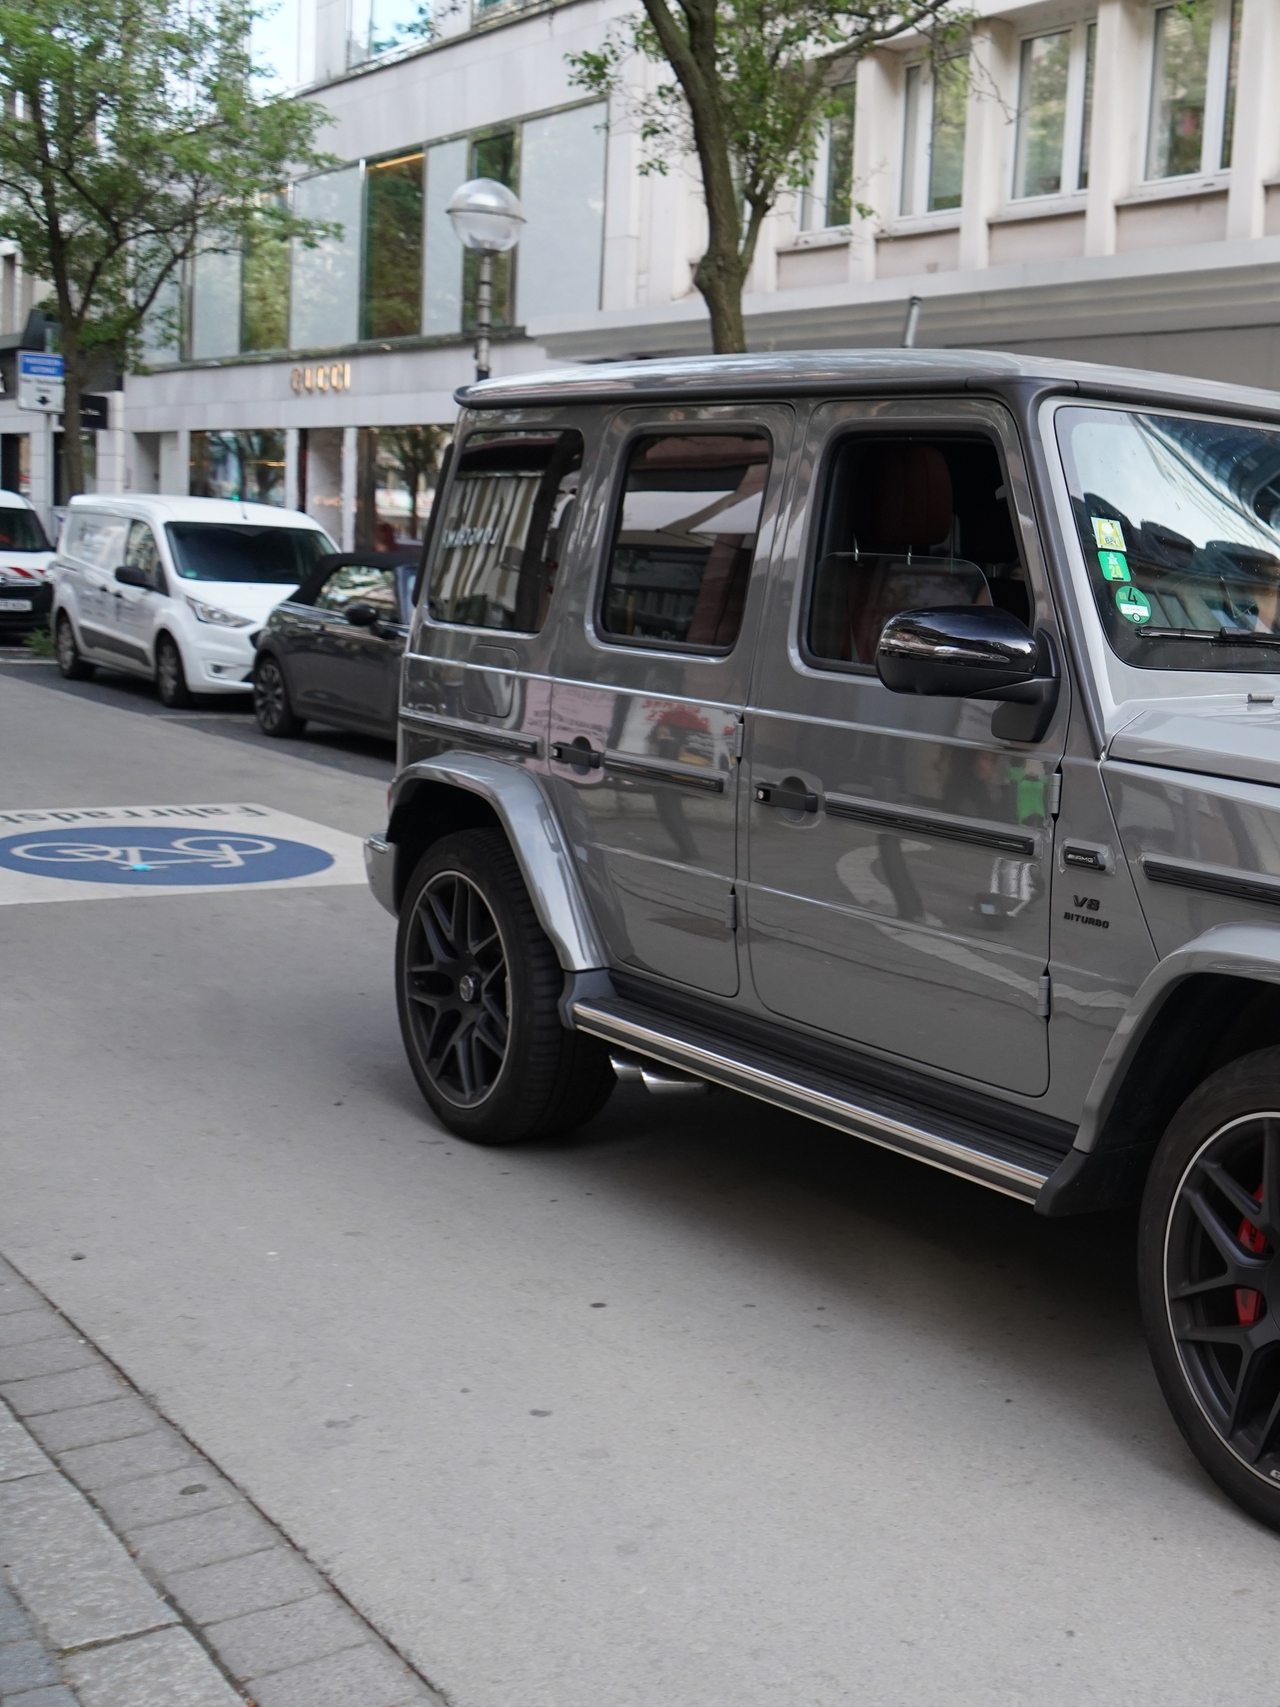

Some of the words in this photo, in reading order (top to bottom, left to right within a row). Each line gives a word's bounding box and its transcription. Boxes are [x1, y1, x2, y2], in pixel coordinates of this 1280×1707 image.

[289, 362, 351, 394] GUCCI
[1127, 587, 1138, 605] 4
[1073, 895, 1101, 911] V8
[1063, 912, 1110, 929] BITURBO
